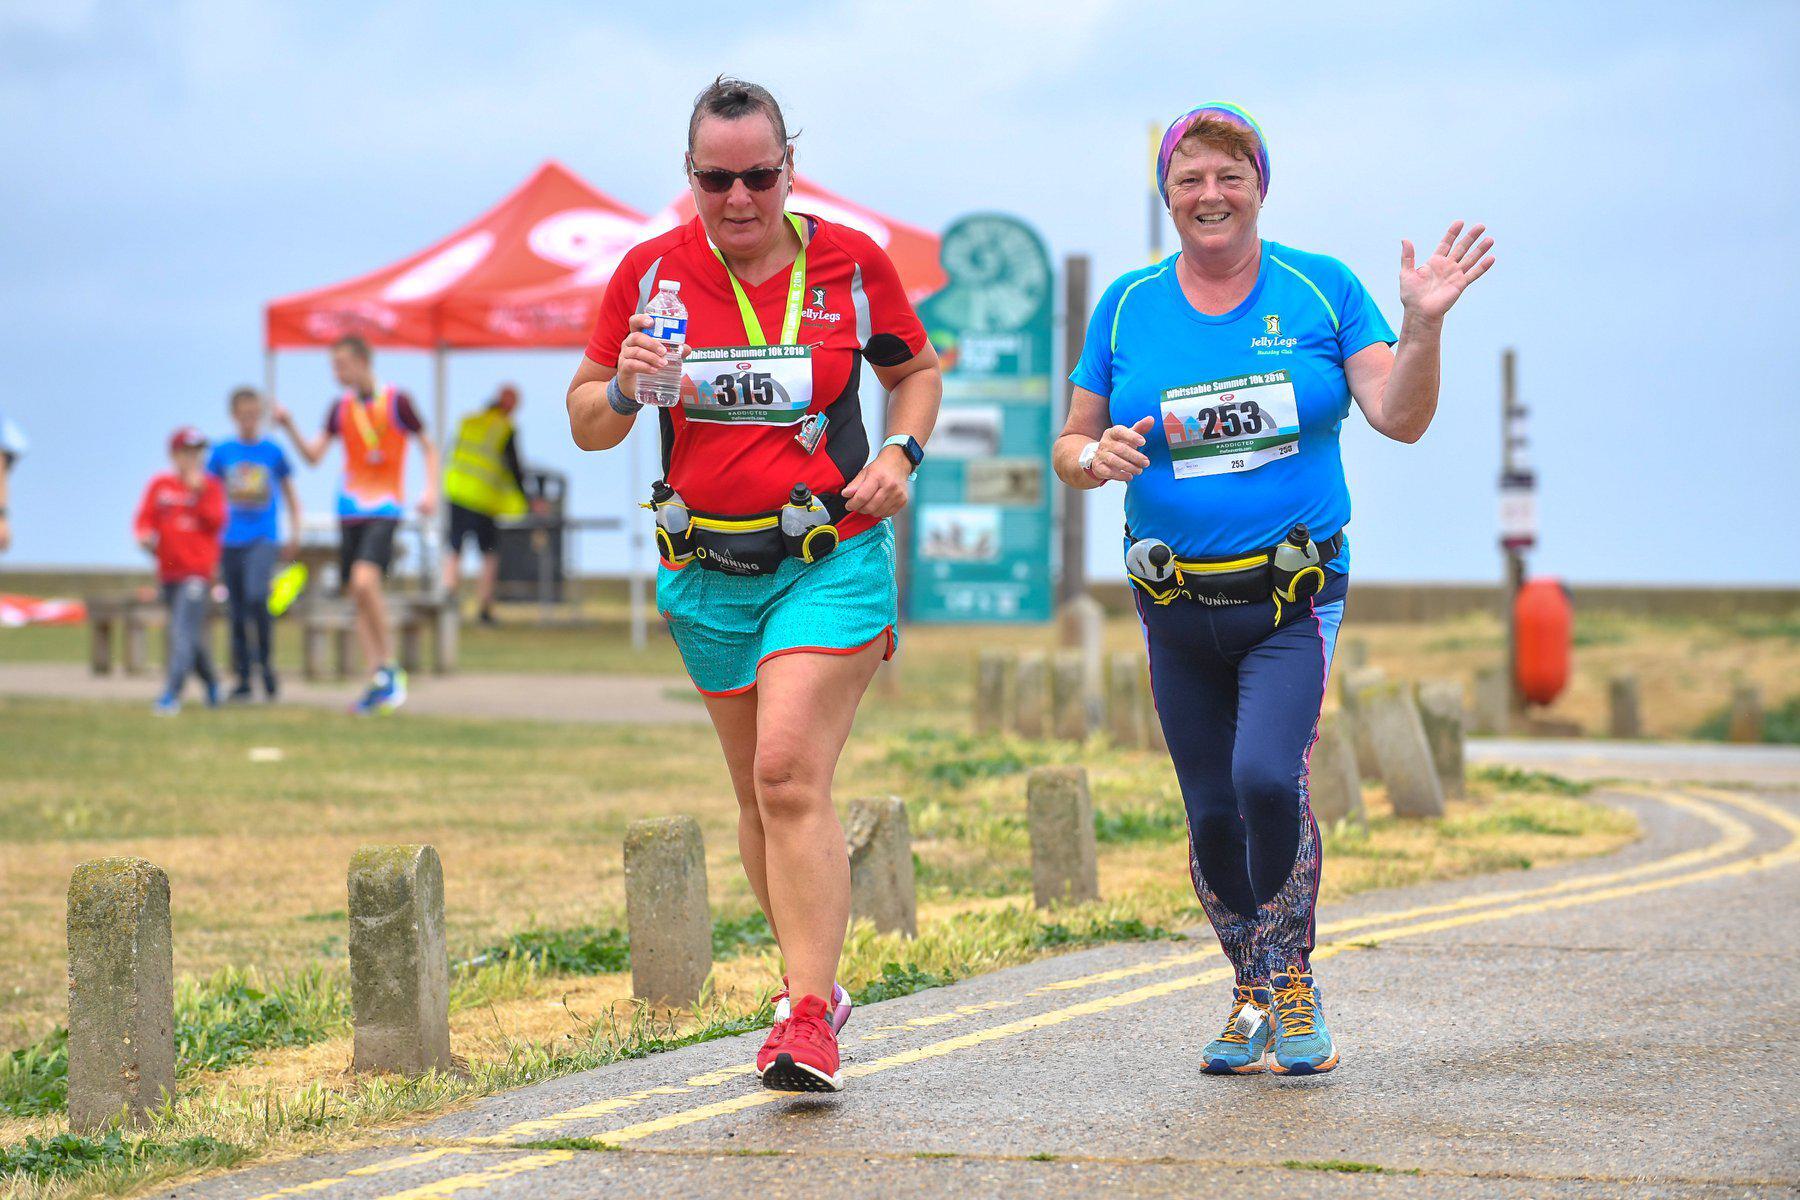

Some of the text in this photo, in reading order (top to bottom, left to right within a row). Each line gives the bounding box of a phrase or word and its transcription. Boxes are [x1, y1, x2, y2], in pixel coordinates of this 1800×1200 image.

[801, 308, 841, 323] ellyLegs
[730, 347, 766, 358] Summer
[768, 346, 783, 357] 10k
[783, 346, 805, 356] 2018
[715, 373, 774, 406] 315
[1166, 372, 1285, 399] Whitstable Summer 10k 2018
[1198, 400, 1262, 440] 253
[1216, 440, 1255, 449] #ADDICTED
[1231, 459, 1245, 469] 253
[709, 548, 760, 571] RUNNING
